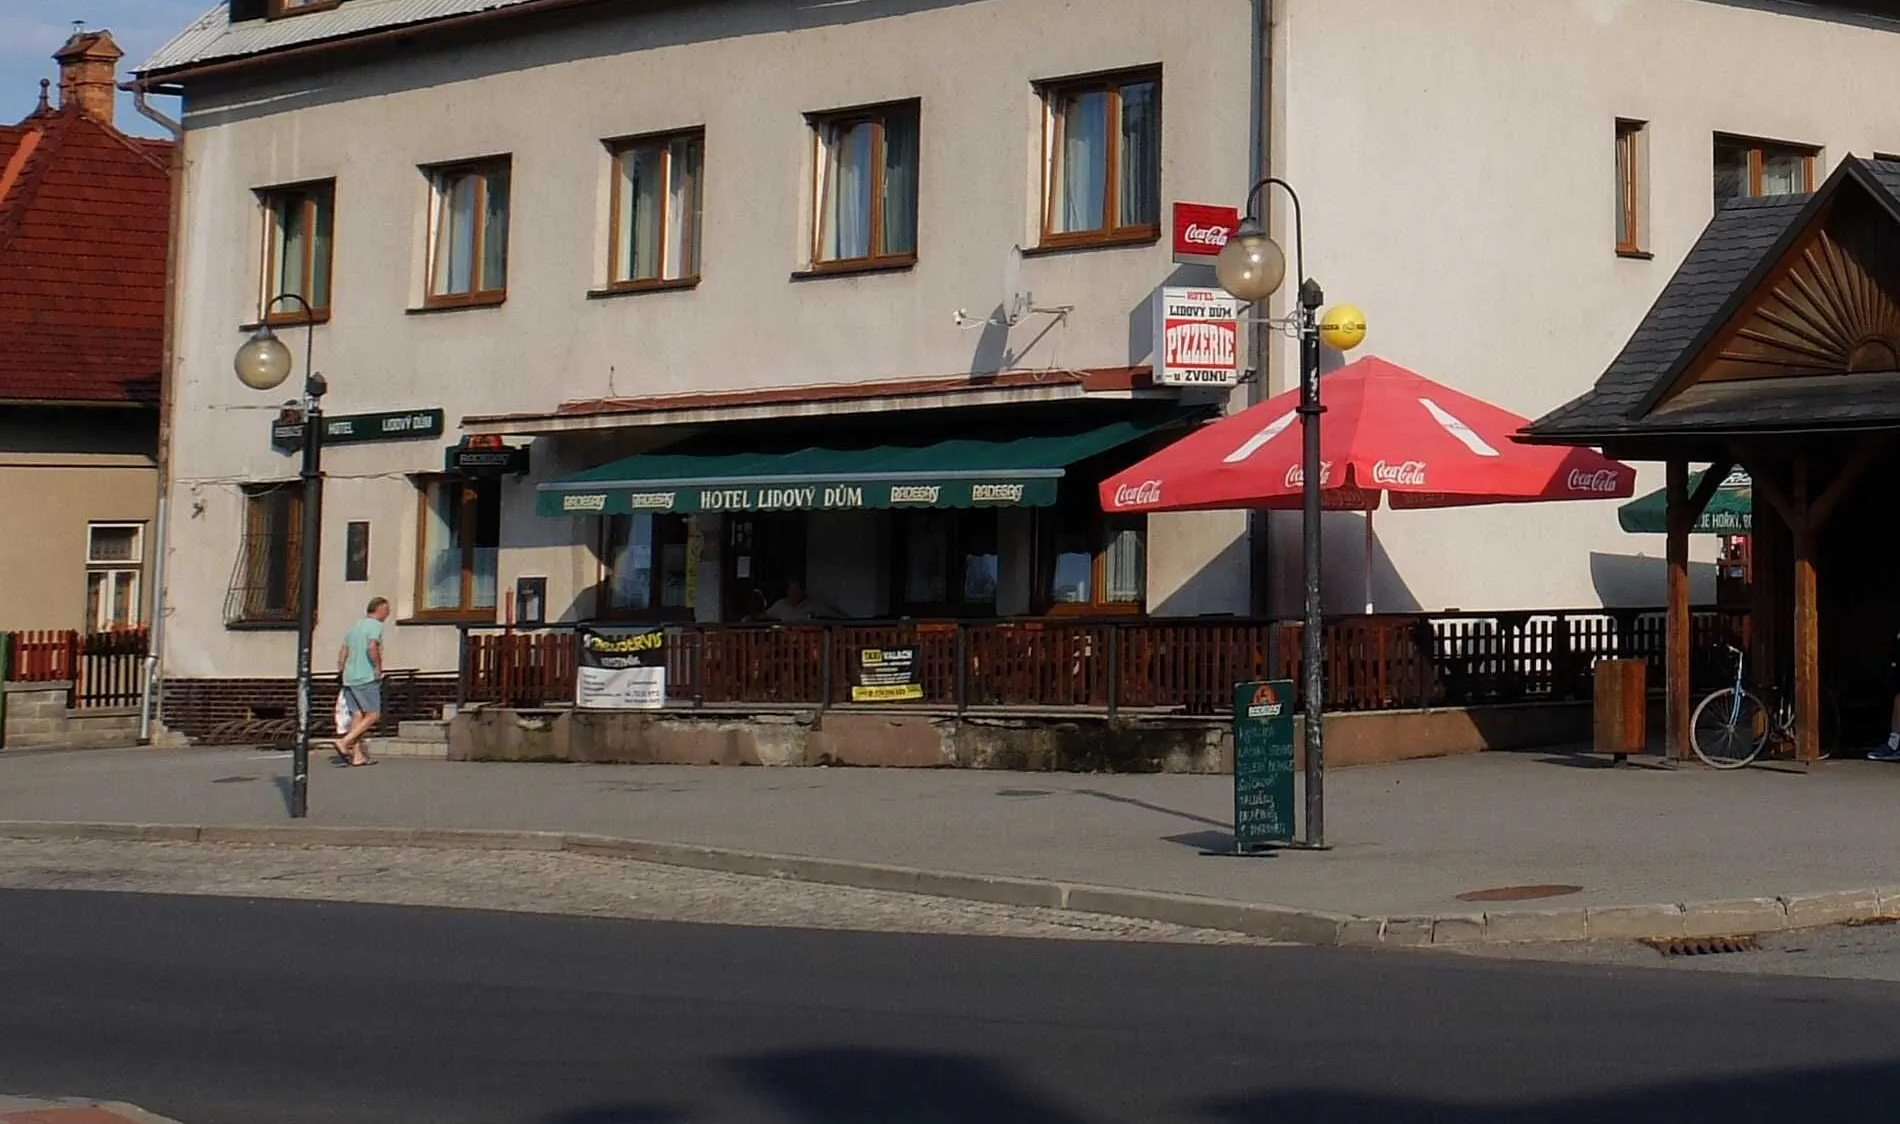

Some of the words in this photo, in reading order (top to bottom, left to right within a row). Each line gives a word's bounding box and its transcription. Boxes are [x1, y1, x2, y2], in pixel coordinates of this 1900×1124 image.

[1187, 292, 1214, 301] HOTEL
[1170, 303, 1207, 317] LIDOVÝ
[1208, 303, 1231, 317] DŮM
[1166, 323, 1234, 365] PIZZERIE
[1185, 370, 1227, 382] ZVONU
[328, 422, 353, 435] HOTEL
[382, 417, 411, 431] LIDOVÝ
[1373, 460, 1426, 485] Coca-Cola
[1567, 468, 1618, 492] Coca-Cola
[700, 489, 750, 509] HOTEL
[757, 485, 816, 509] LIDOVÝ
[824, 484, 862, 507] DŮM
[1114, 480, 1162, 506] Coca-Cola
